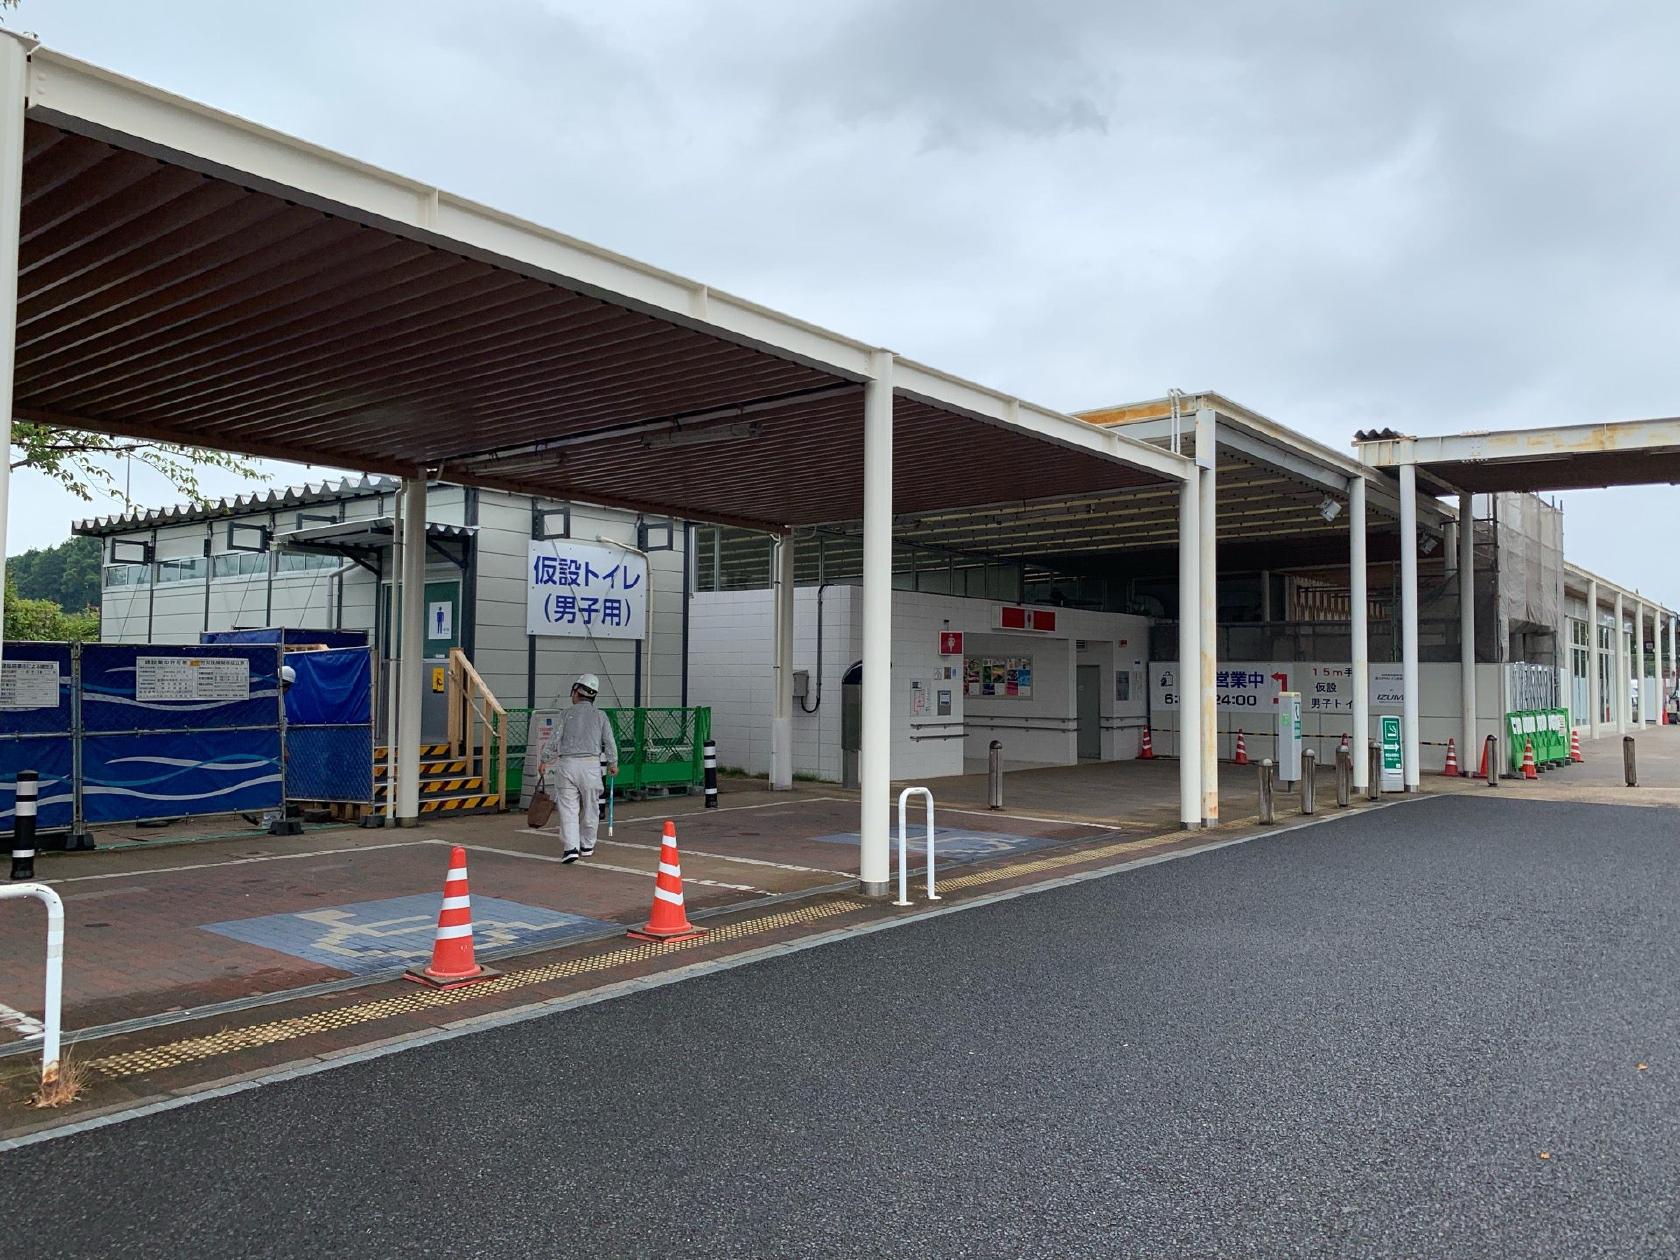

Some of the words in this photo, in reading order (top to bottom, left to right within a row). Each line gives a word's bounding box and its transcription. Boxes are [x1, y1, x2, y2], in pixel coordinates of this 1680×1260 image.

[534, 555, 641, 590] 仮設トイレ
[544, 593, 631, 627] （男子用）
[1216, 671, 1265, 689] 営業中
[1315, 682, 1337, 693] 仮設
[1164, 693, 1181, 705] 6:
